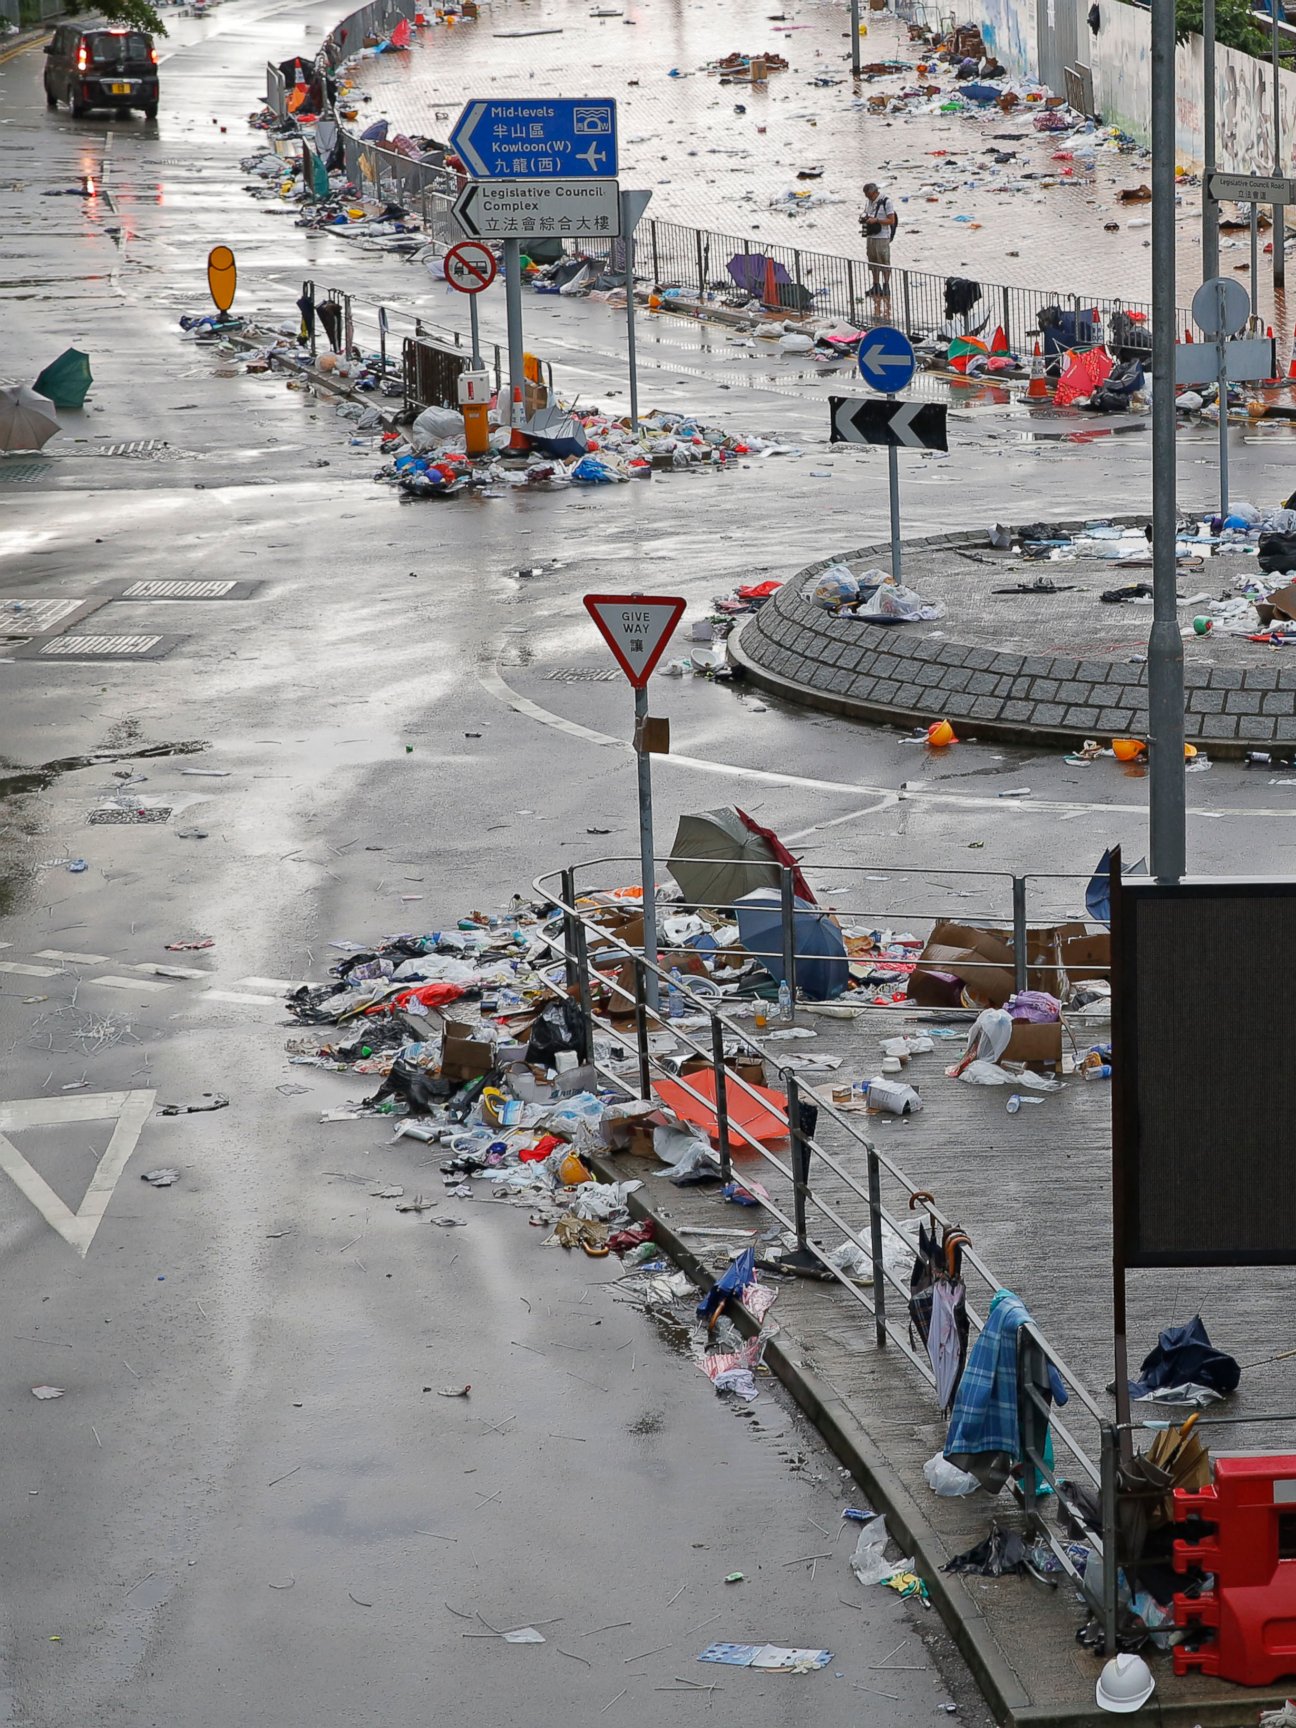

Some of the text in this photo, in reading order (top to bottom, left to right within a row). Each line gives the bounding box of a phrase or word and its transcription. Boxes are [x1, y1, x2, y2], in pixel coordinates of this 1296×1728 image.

[491, 106, 555, 118] Mid-levels
[492, 123, 545, 138] 半山區
[491, 140, 572, 153] Kowloon(W)
[494, 158, 561, 173] 九龍(西)
[482, 187, 604, 199] Legislative Council
[483, 201, 539, 213] Complex
[485, 216, 610, 231] 立法會綜合大樓
[621, 612, 650, 621] GIVE
[623, 624, 650, 633] WAY
